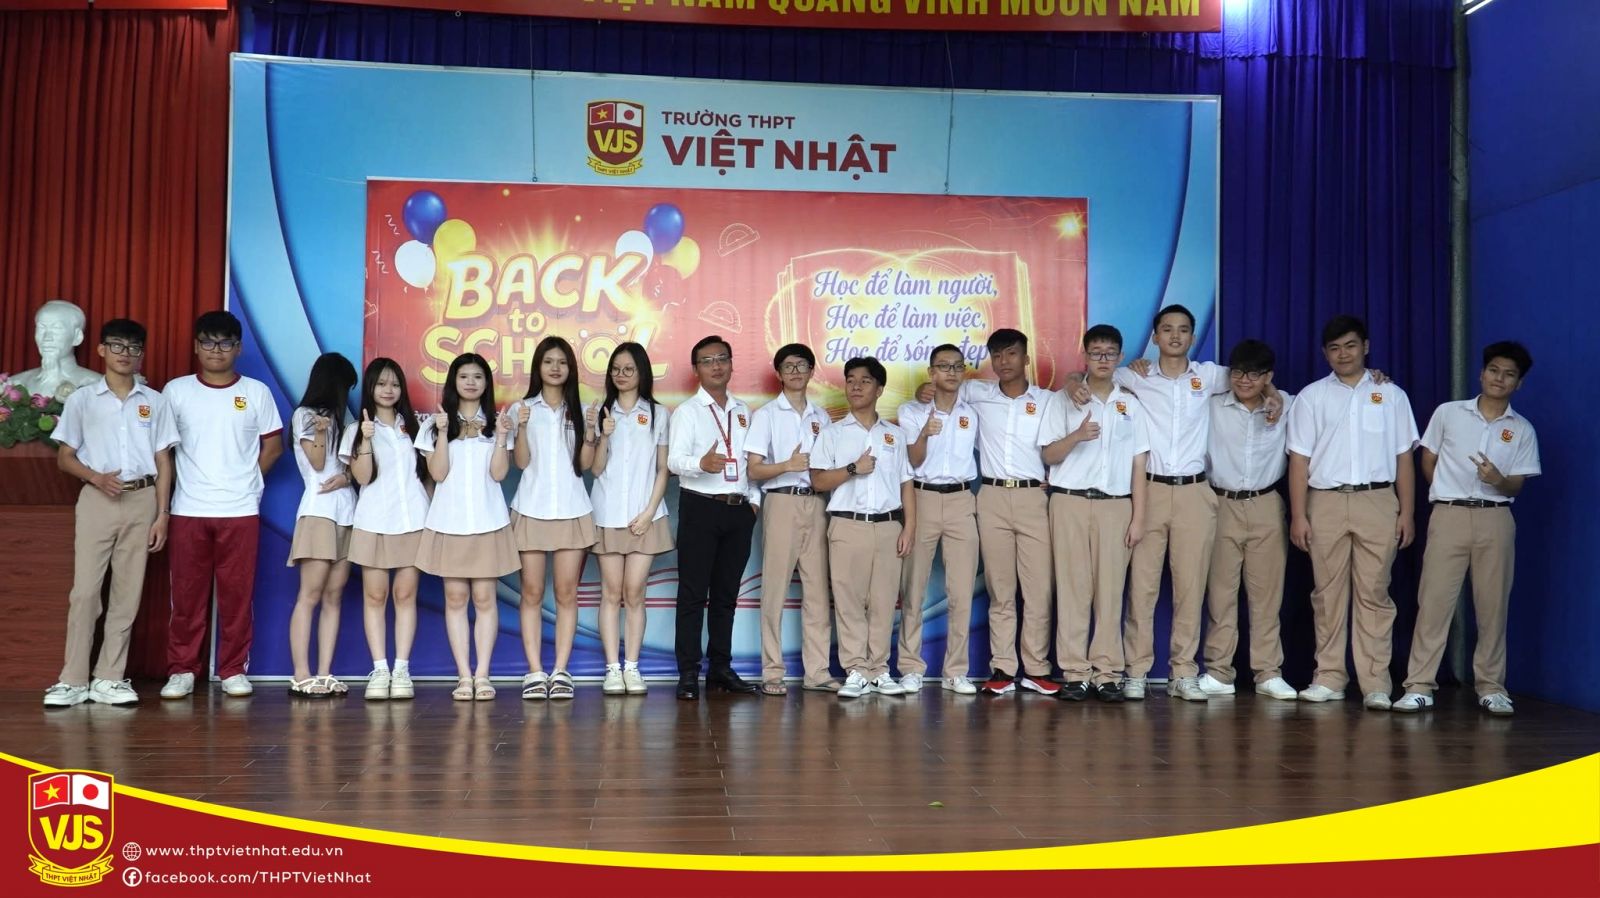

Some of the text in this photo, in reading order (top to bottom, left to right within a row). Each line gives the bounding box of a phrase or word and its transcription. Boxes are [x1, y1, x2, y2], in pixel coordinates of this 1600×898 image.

[661, 108, 796, 130] TRƯỜNG THPT
[593, 128, 638, 154] VJS
[661, 128, 897, 181] VIỆT NHẬT
[443, 252, 645, 321] BACK
[813, 268, 998, 304] Học để làm người,
[508, 307, 546, 334] to
[825, 302, 986, 333] Học để làm việc,
[419, 321, 669, 385] SCHOL
[874, 334, 902, 362] để
